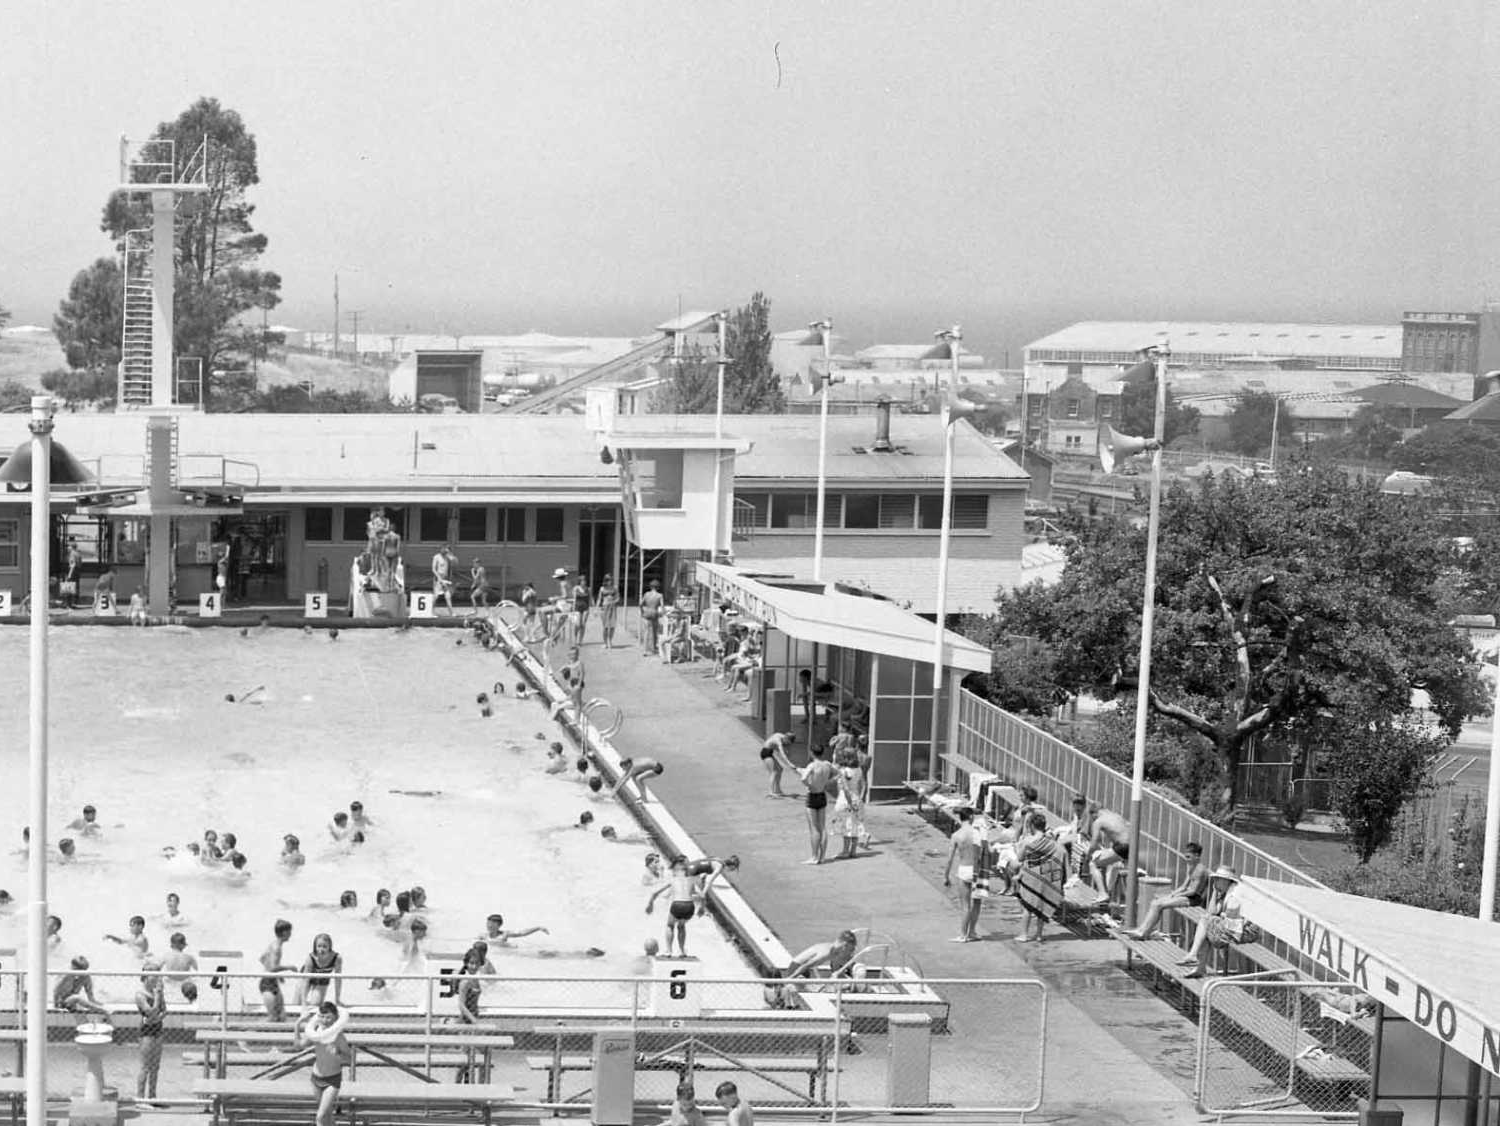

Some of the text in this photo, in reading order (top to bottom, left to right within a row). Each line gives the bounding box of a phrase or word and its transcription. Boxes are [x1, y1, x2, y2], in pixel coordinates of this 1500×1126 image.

[101, 595, 109, 609] 3
[205, 595, 215, 611] 4
[312, 595, 321, 610] 5
[418, 596, 426, 611] 6
[670, 969, 686, 999] 6
[1299, 914, 1369, 990] WALK
[1414, 983, 1457, 1042] DO
